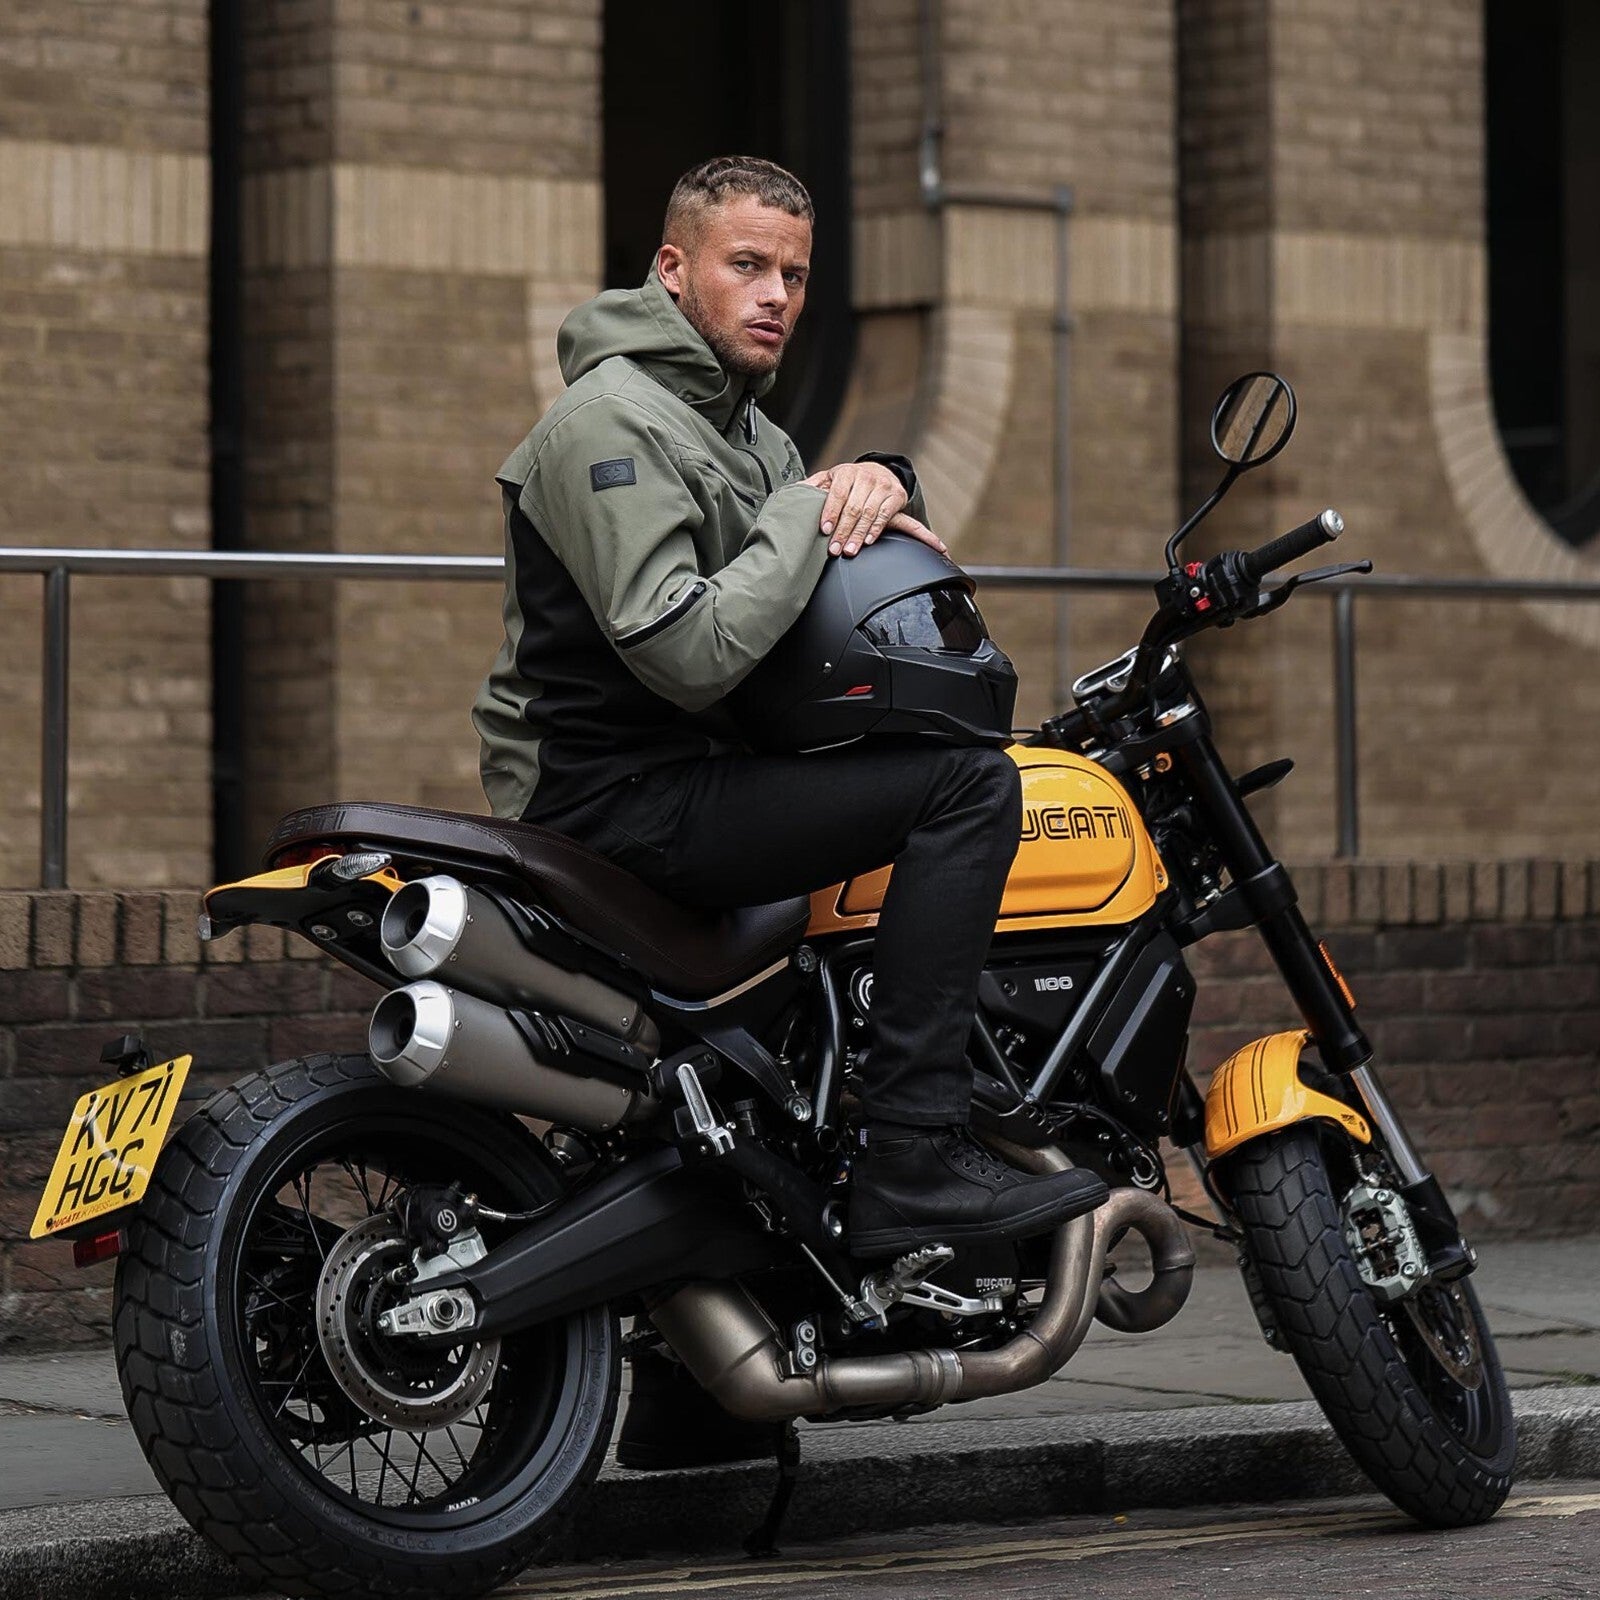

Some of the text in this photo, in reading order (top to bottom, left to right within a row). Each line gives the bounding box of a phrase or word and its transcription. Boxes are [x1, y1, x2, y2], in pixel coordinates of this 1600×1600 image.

[1020, 806, 1131, 841] UCATI
[1034, 975, 1073, 992] 1100
[71, 1073, 174, 1156] KV71
[55, 1138, 145, 1215] HGG
